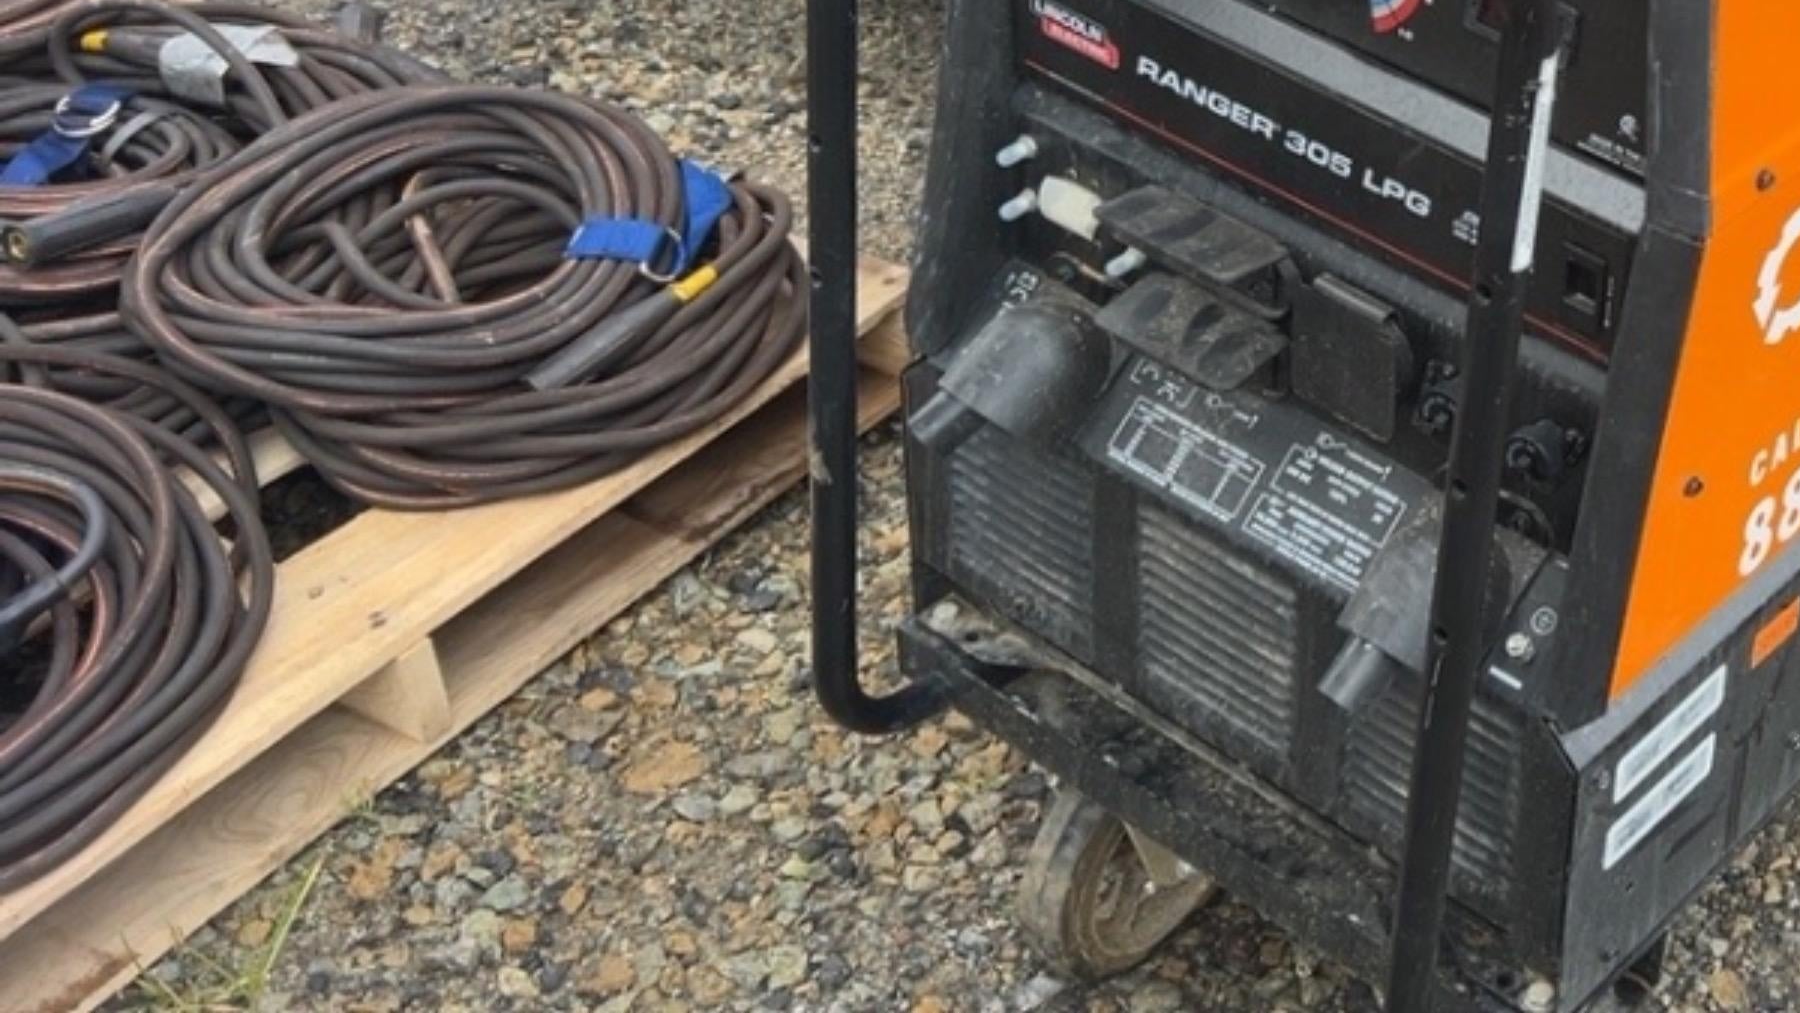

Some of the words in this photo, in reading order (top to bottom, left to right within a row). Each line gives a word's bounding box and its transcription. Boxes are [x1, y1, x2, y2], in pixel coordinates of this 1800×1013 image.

[1136, 55, 1276, 141] RANGER
[1283, 129, 1353, 179] 305
[1361, 167, 1432, 217] LPG
